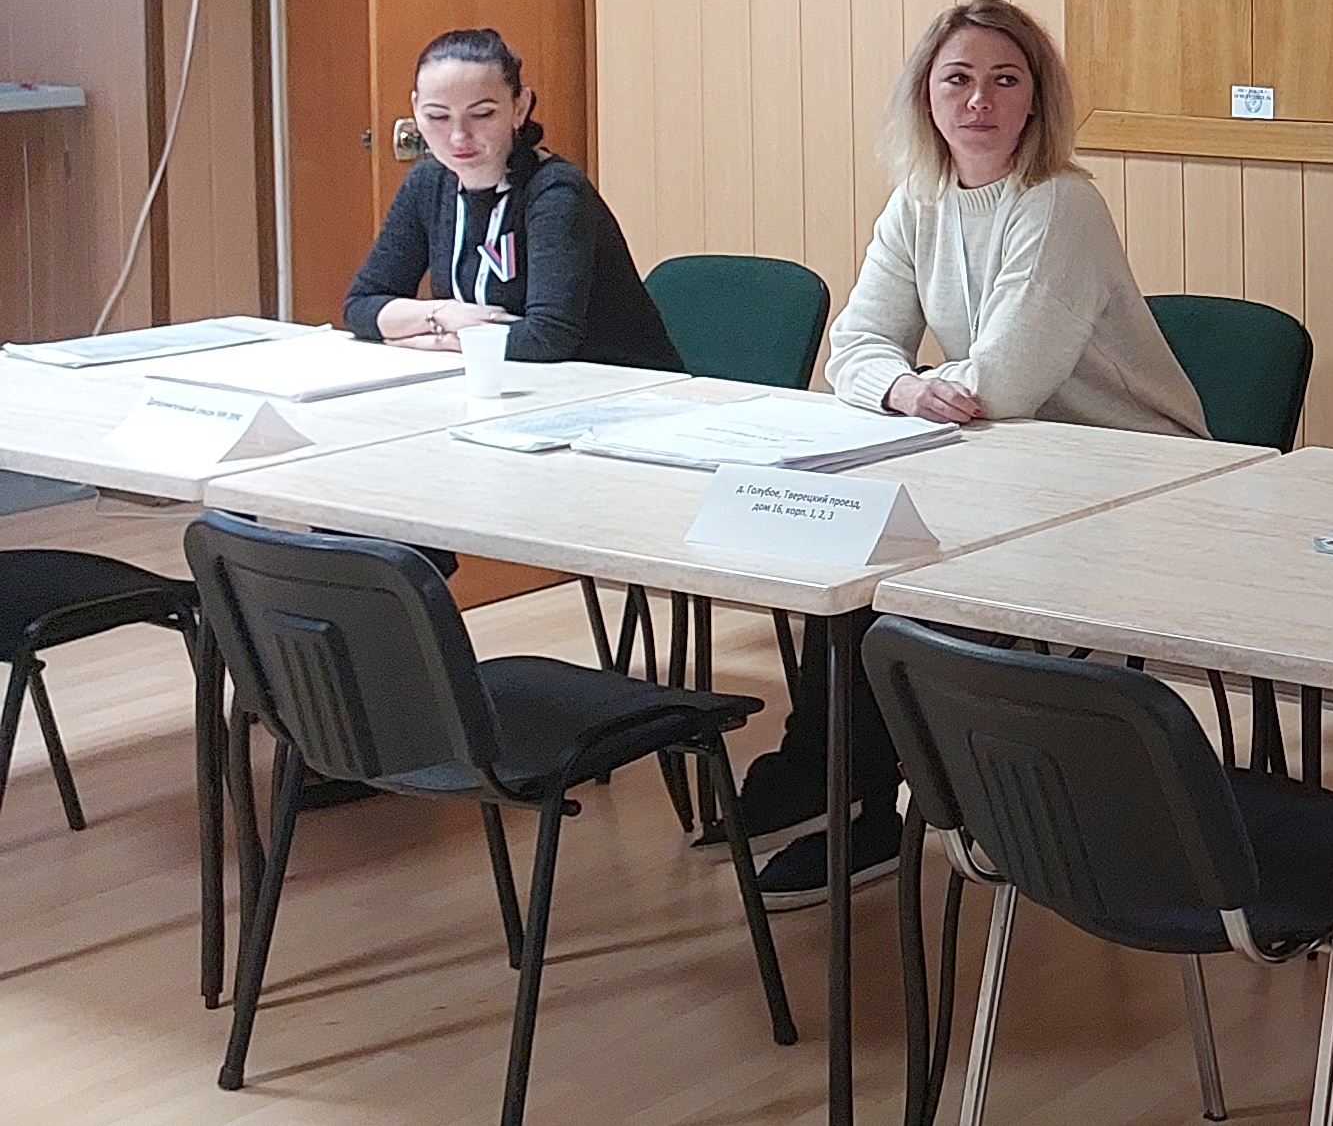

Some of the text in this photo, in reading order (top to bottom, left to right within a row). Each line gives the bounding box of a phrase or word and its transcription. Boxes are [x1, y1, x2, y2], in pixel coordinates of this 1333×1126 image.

[747, 484, 781, 499] Голубое,
[784, 489, 829, 504] Тверецкий
[751, 503, 771, 512] дом
